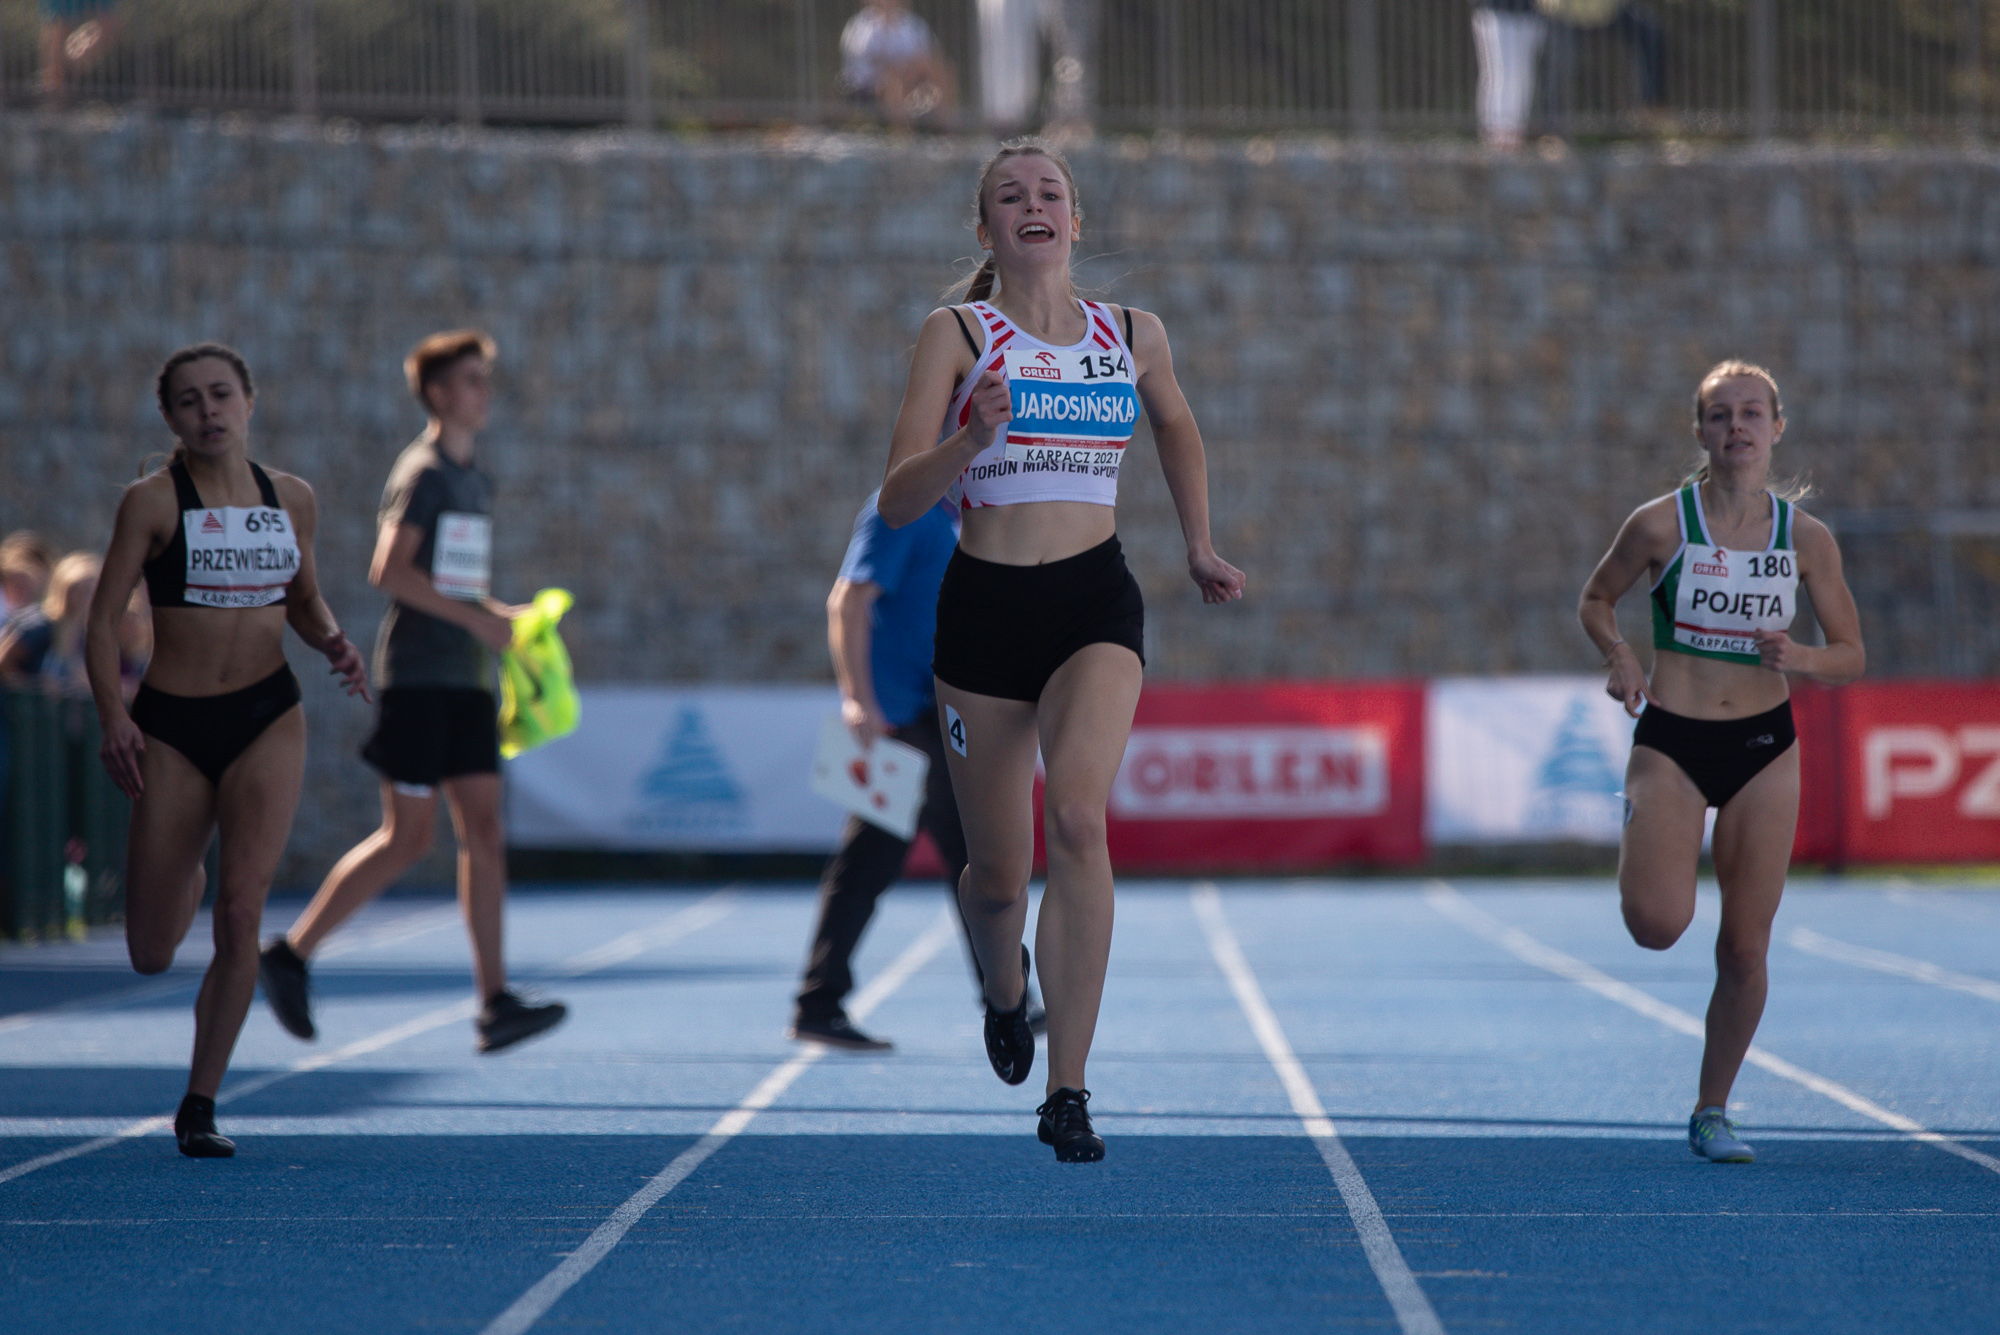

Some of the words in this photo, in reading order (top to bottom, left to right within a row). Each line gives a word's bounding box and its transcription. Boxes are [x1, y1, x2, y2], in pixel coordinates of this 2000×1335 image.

[1022, 367, 1060, 379] ORLEN
[1079, 354, 1129, 379] 154
[1016, 391, 1135, 423] JAROSIŃSKA
[1026, 449, 1090, 463] KARPACZ
[1094, 452, 1119, 464] 2021
[246, 511, 286, 533] 695
[1748, 556, 1792, 578] 180
[1691, 589, 1783, 620] POJĘTA
[1690, 634, 1747, 652] KARPACZ
[950, 718, 964, 748] 4
